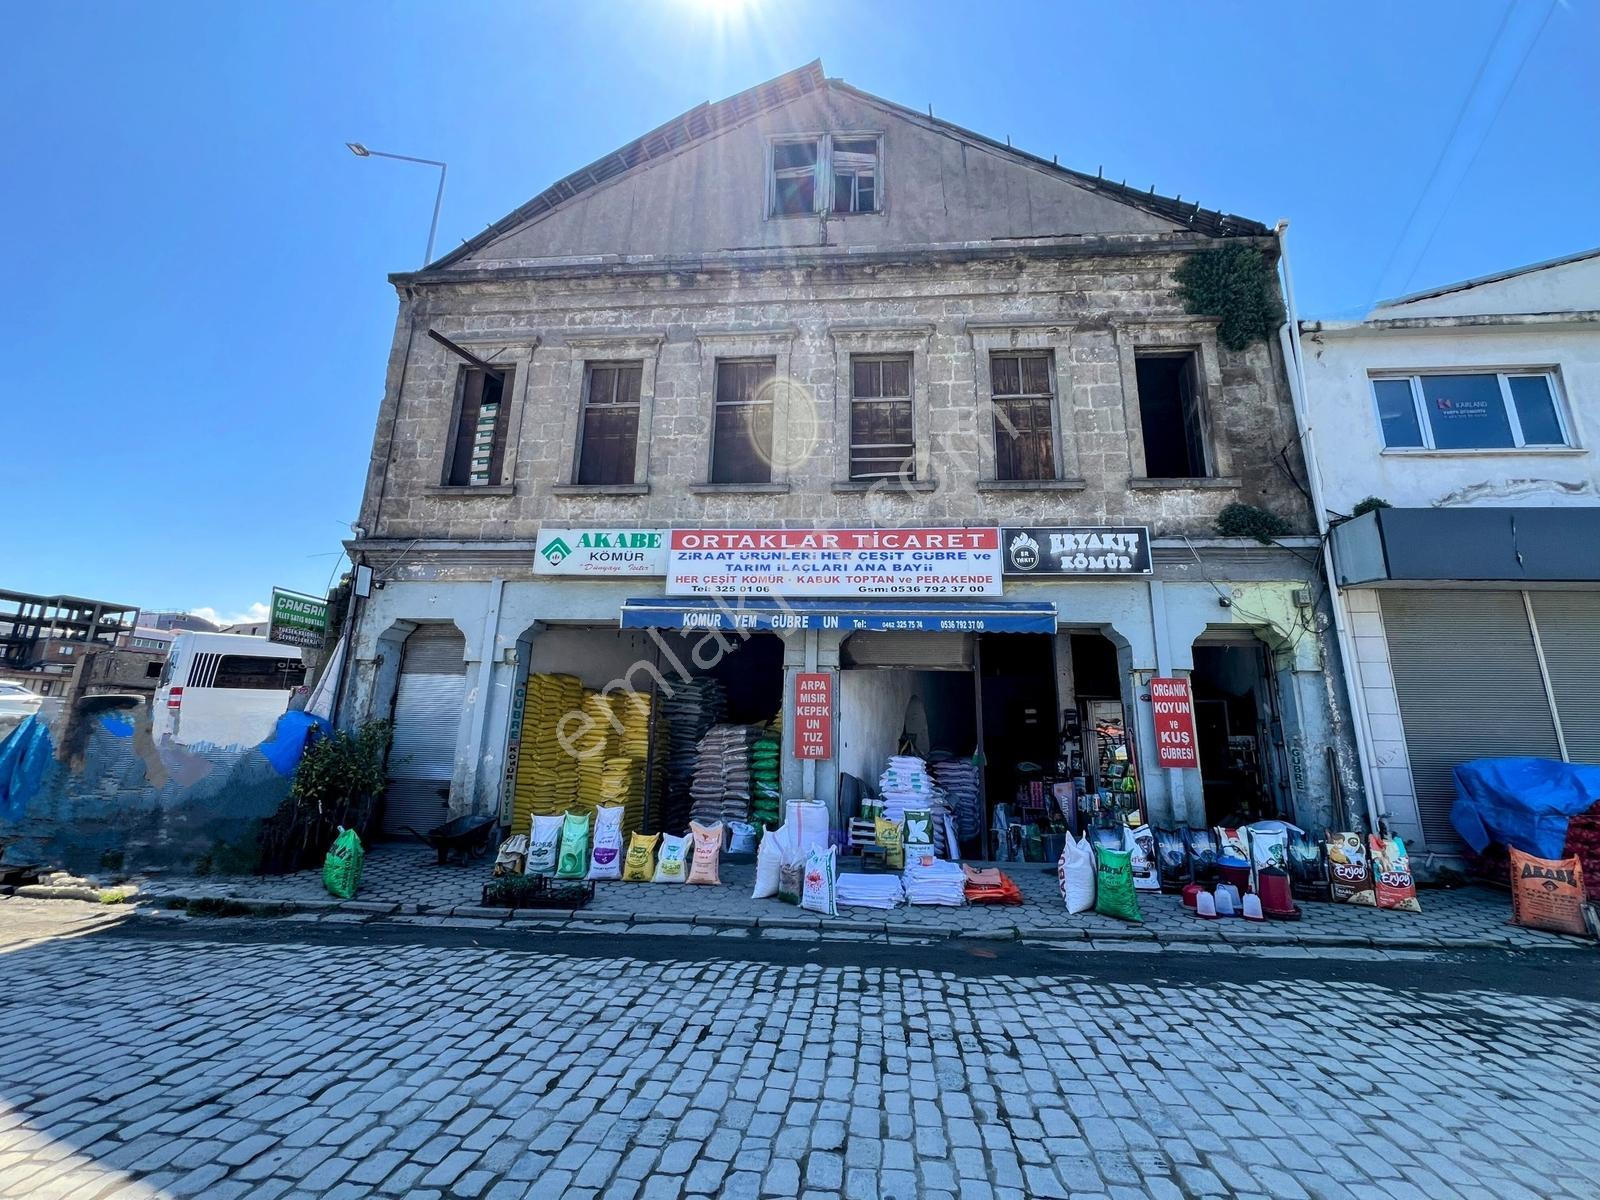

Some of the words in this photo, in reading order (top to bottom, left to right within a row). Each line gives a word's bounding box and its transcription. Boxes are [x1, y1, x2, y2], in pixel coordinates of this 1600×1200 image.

[576, 532, 663, 548] AKABE
[681, 534, 840, 548] ORTAKLAR
[852, 531, 985, 548] TİCARET
[1049, 533, 1139, 554] ERYAKIT
[590, 551, 644, 561] KÖMÜR
[821, 552, 852, 560] HER
[1060, 553, 1132, 568] KÖMÜR
[726, 564, 771, 572] TARIM
[854, 564, 887, 572] ANA
[675, 575, 699, 583] HER
[742, 573, 784, 583] KÖMÜR
[797, 575, 840, 583] KABUK
[846, 575, 894, 583] TOPTAN
[916, 575, 993, 583] PERAKENDE
[277, 597, 326, 617] ÇAMSAN
[734, 614, 757, 628] YEM
[823, 615, 839, 628] UN
[853, 619, 867, 628] Tel:
[800, 680, 827, 691] ARPA
[800, 693, 826, 703] MISIR
[796, 706, 830, 716] KEPEK
[1154, 702, 1190, 714] KOYUN
[806, 719, 820, 729] UN
[1169, 720, 1179, 729] ve
[803, 732, 823, 742] TUZ
[1160, 731, 1190, 746] KUŞ
[802, 745, 824, 756] YEM
[1161, 745, 1194, 759] GÜBRESİ
[1336, 865, 1366, 879] Enjoy
[1381, 871, 1411, 886] Enjoy
